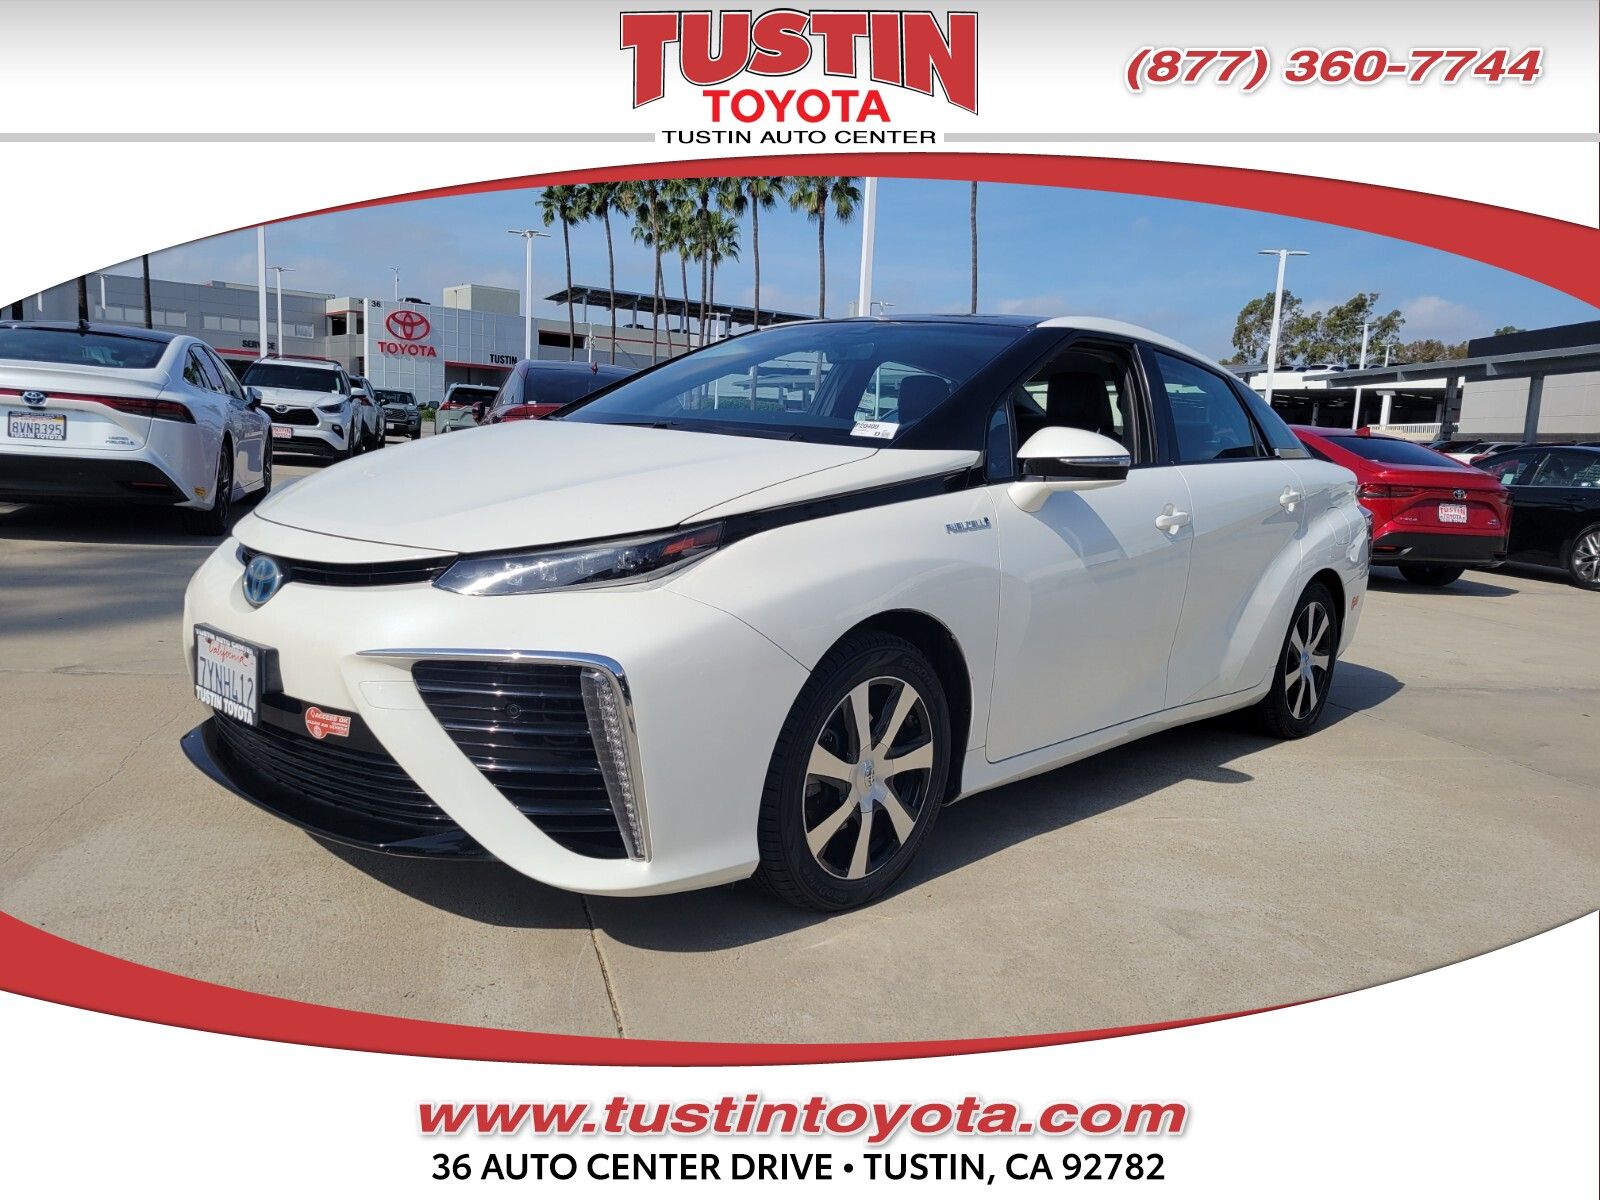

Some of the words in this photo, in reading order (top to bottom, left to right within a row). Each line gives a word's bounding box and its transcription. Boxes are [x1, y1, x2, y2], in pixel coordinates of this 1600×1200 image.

[377, 341, 437, 357] TOYOTA
[489, 353, 518, 364] TUSTIN
[195, 685, 223, 711] TUSTIN
[223, 697, 254, 726] TOYOTA
